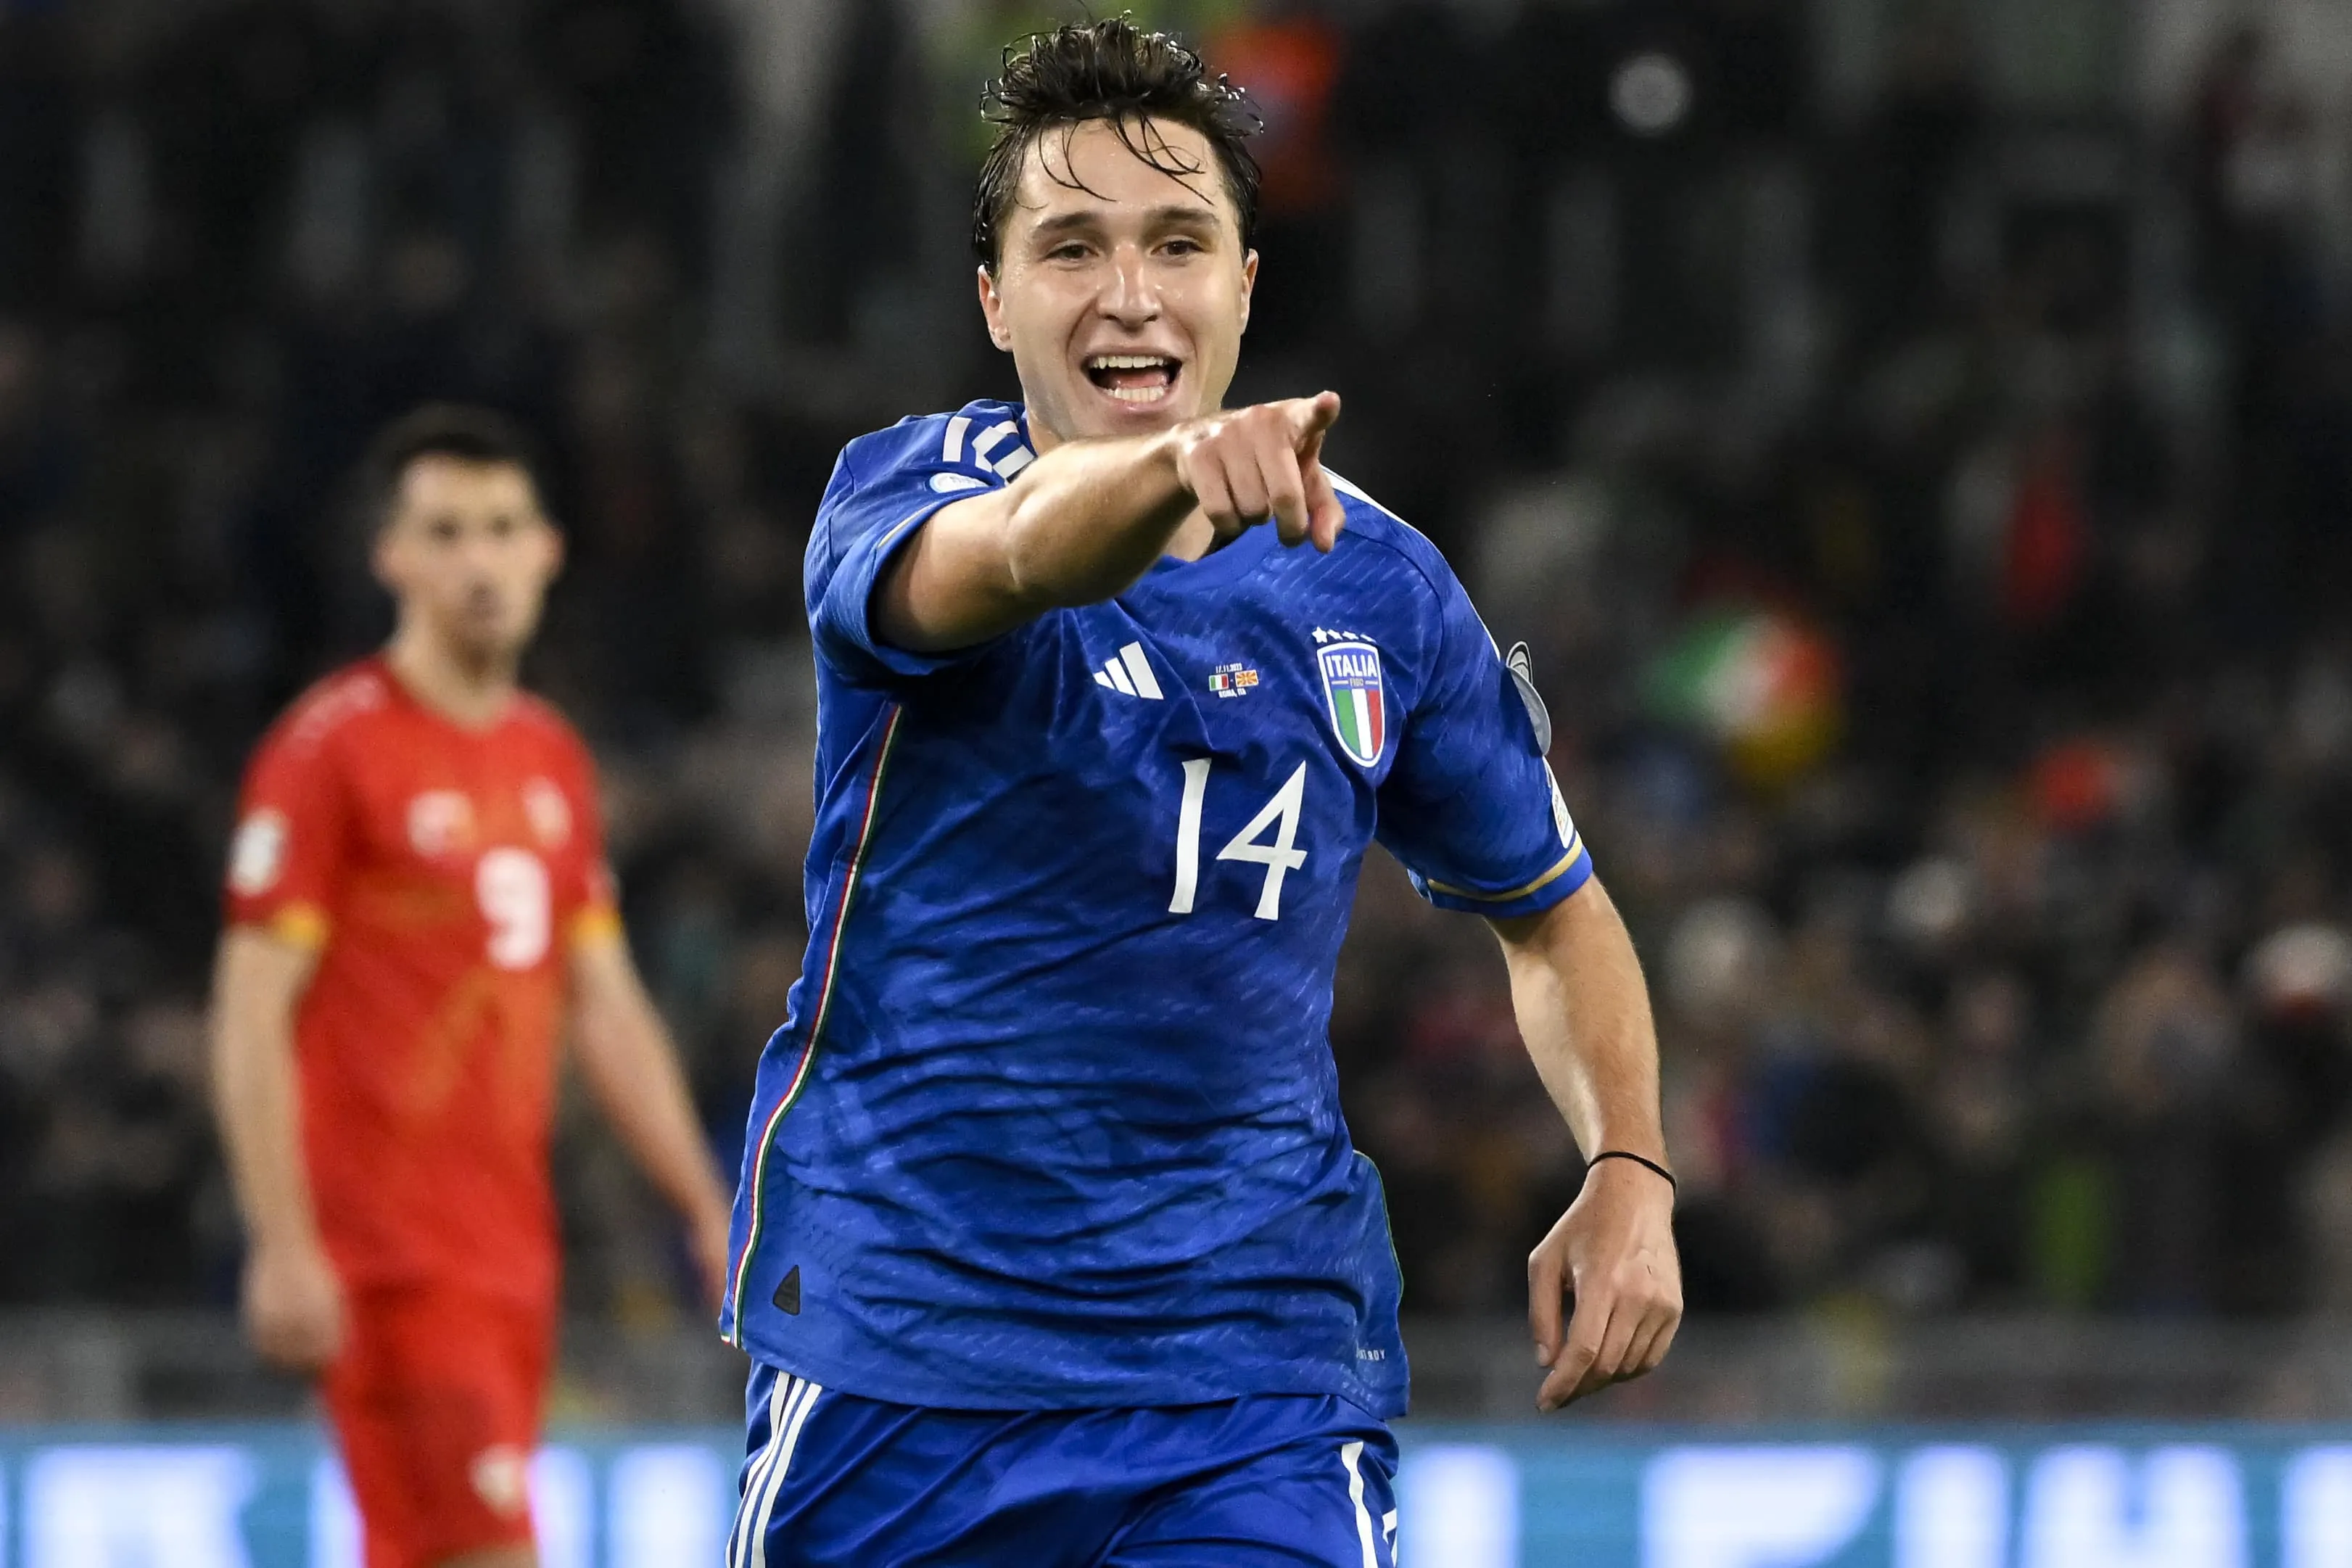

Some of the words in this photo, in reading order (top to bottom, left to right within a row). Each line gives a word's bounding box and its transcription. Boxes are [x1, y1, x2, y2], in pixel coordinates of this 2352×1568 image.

[1325, 654, 1377, 677] ITALIA
[1168, 757, 1308, 921] 14
[476, 846, 550, 970] 9
